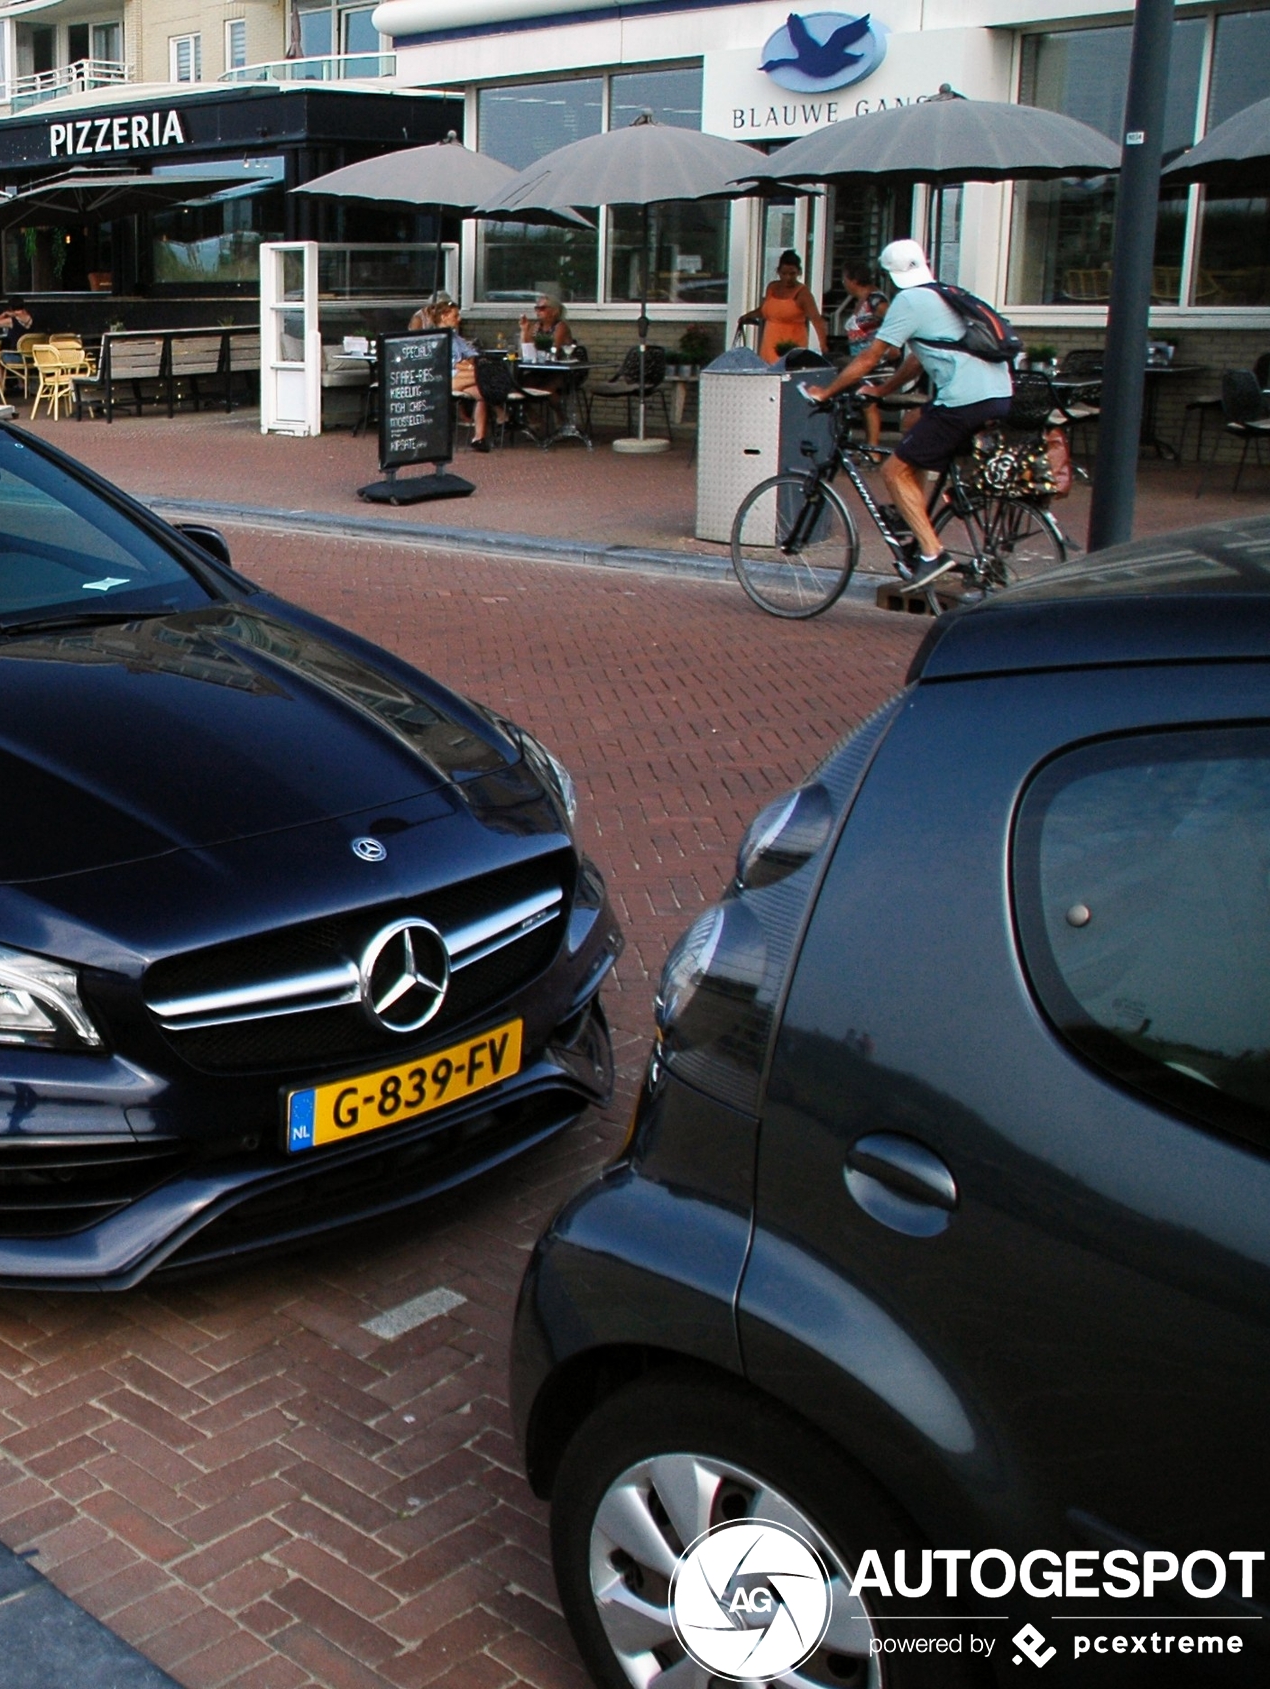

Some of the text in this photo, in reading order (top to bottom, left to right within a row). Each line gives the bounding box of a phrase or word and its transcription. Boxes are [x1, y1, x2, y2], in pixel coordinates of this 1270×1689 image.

[732, 102, 839, 129] BLAUWE
[50, 109, 185, 157] PIZZERIA
[402, 344, 433, 359] SPECIALS
[332, 1032, 510, 1129] G-839-FV
[292, 1125, 311, 1141] NL
